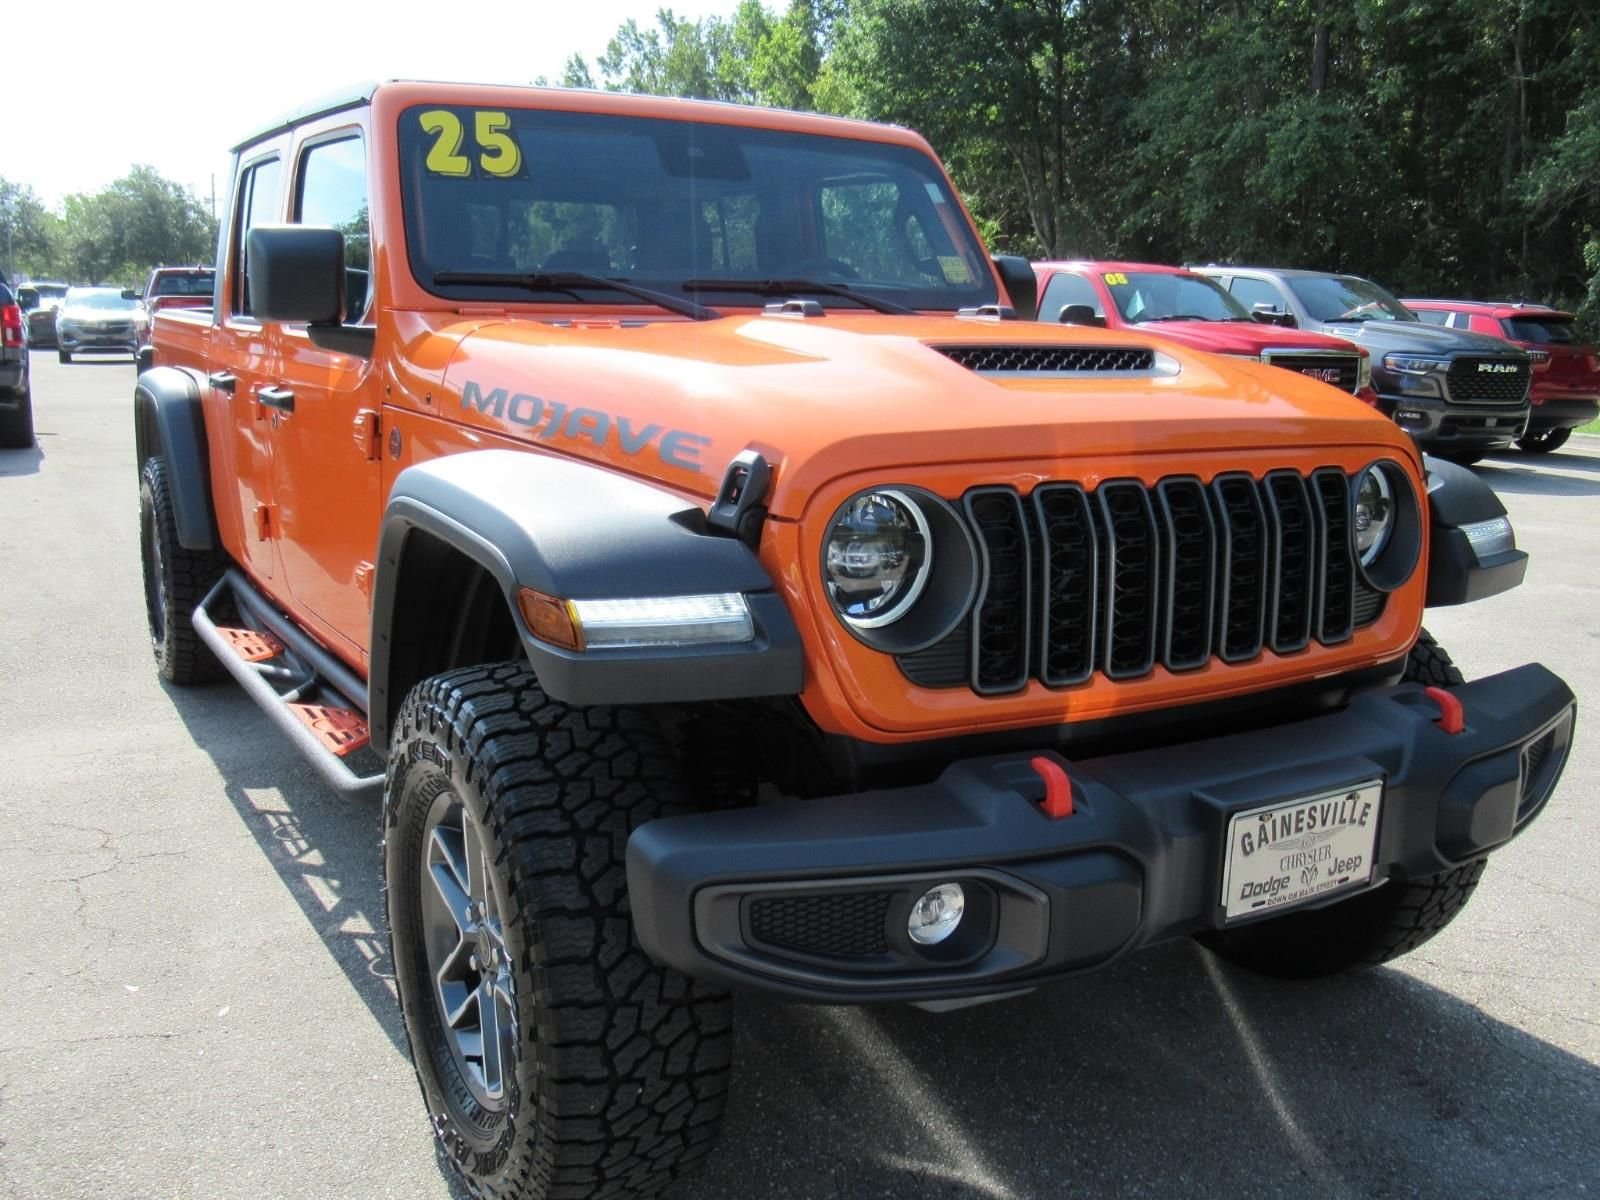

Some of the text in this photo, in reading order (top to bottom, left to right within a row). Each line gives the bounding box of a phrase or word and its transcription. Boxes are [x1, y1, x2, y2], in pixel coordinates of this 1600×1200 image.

[419, 110, 521, 177] 25
[1478, 363, 1518, 373] RAM
[460, 381, 713, 471] MOJAVE
[1240, 800, 1372, 856] GAINESVILLE
[1240, 855, 1362, 900] Dodge Jeep
[1280, 844, 1332, 872] CHRYSLER
